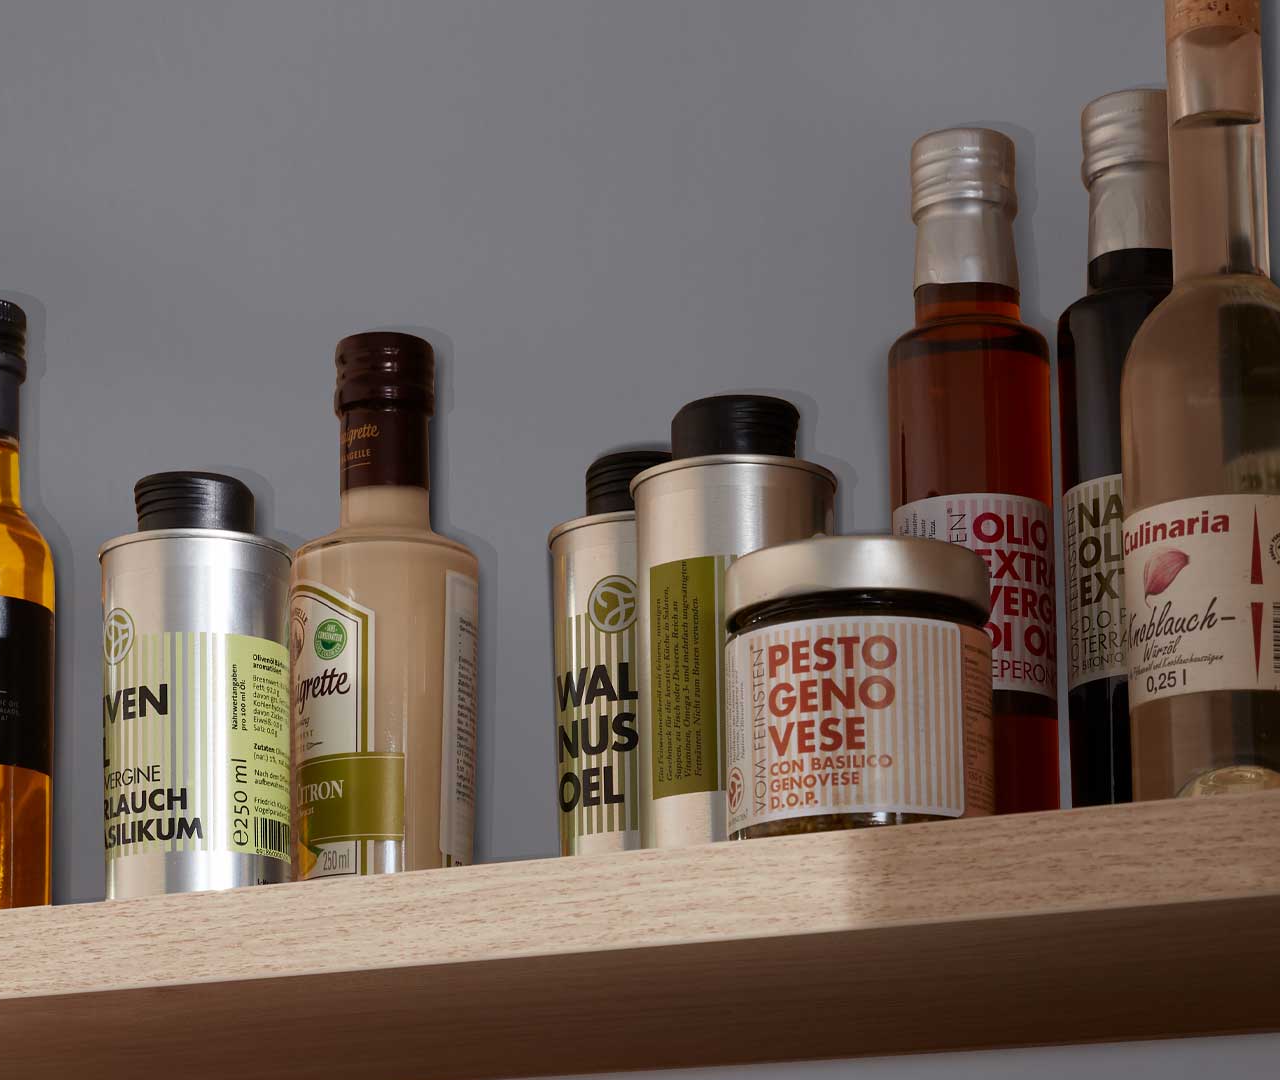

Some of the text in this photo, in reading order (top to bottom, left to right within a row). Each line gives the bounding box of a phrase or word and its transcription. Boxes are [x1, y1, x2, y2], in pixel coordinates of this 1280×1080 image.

[973, 512, 1048, 552] OLIO
[1124, 510, 1230, 556] Culinaria
[768, 635, 897, 678] PESTO
[1143, 635, 1182, 663] Würzöl
[231, 663, 239, 731] Nährwertangaben
[239, 691, 246, 702] ml
[557, 662, 638, 713] WAL
[768, 675, 896, 718] GENO
[1146, 670, 1177, 694] 0,25
[558, 712, 639, 763] NUS
[753, 648, 767, 813] VOM FEINSTEN
[768, 716, 866, 757] VESE
[231, 758, 247, 784] ml
[770, 754, 892, 776] CON BASILICO
[770, 772, 860, 793] GENOVESE
[559, 766, 624, 813] OEL
[770, 792, 819, 810] D.O.P.
[323, 848, 350, 871] 250 ml
